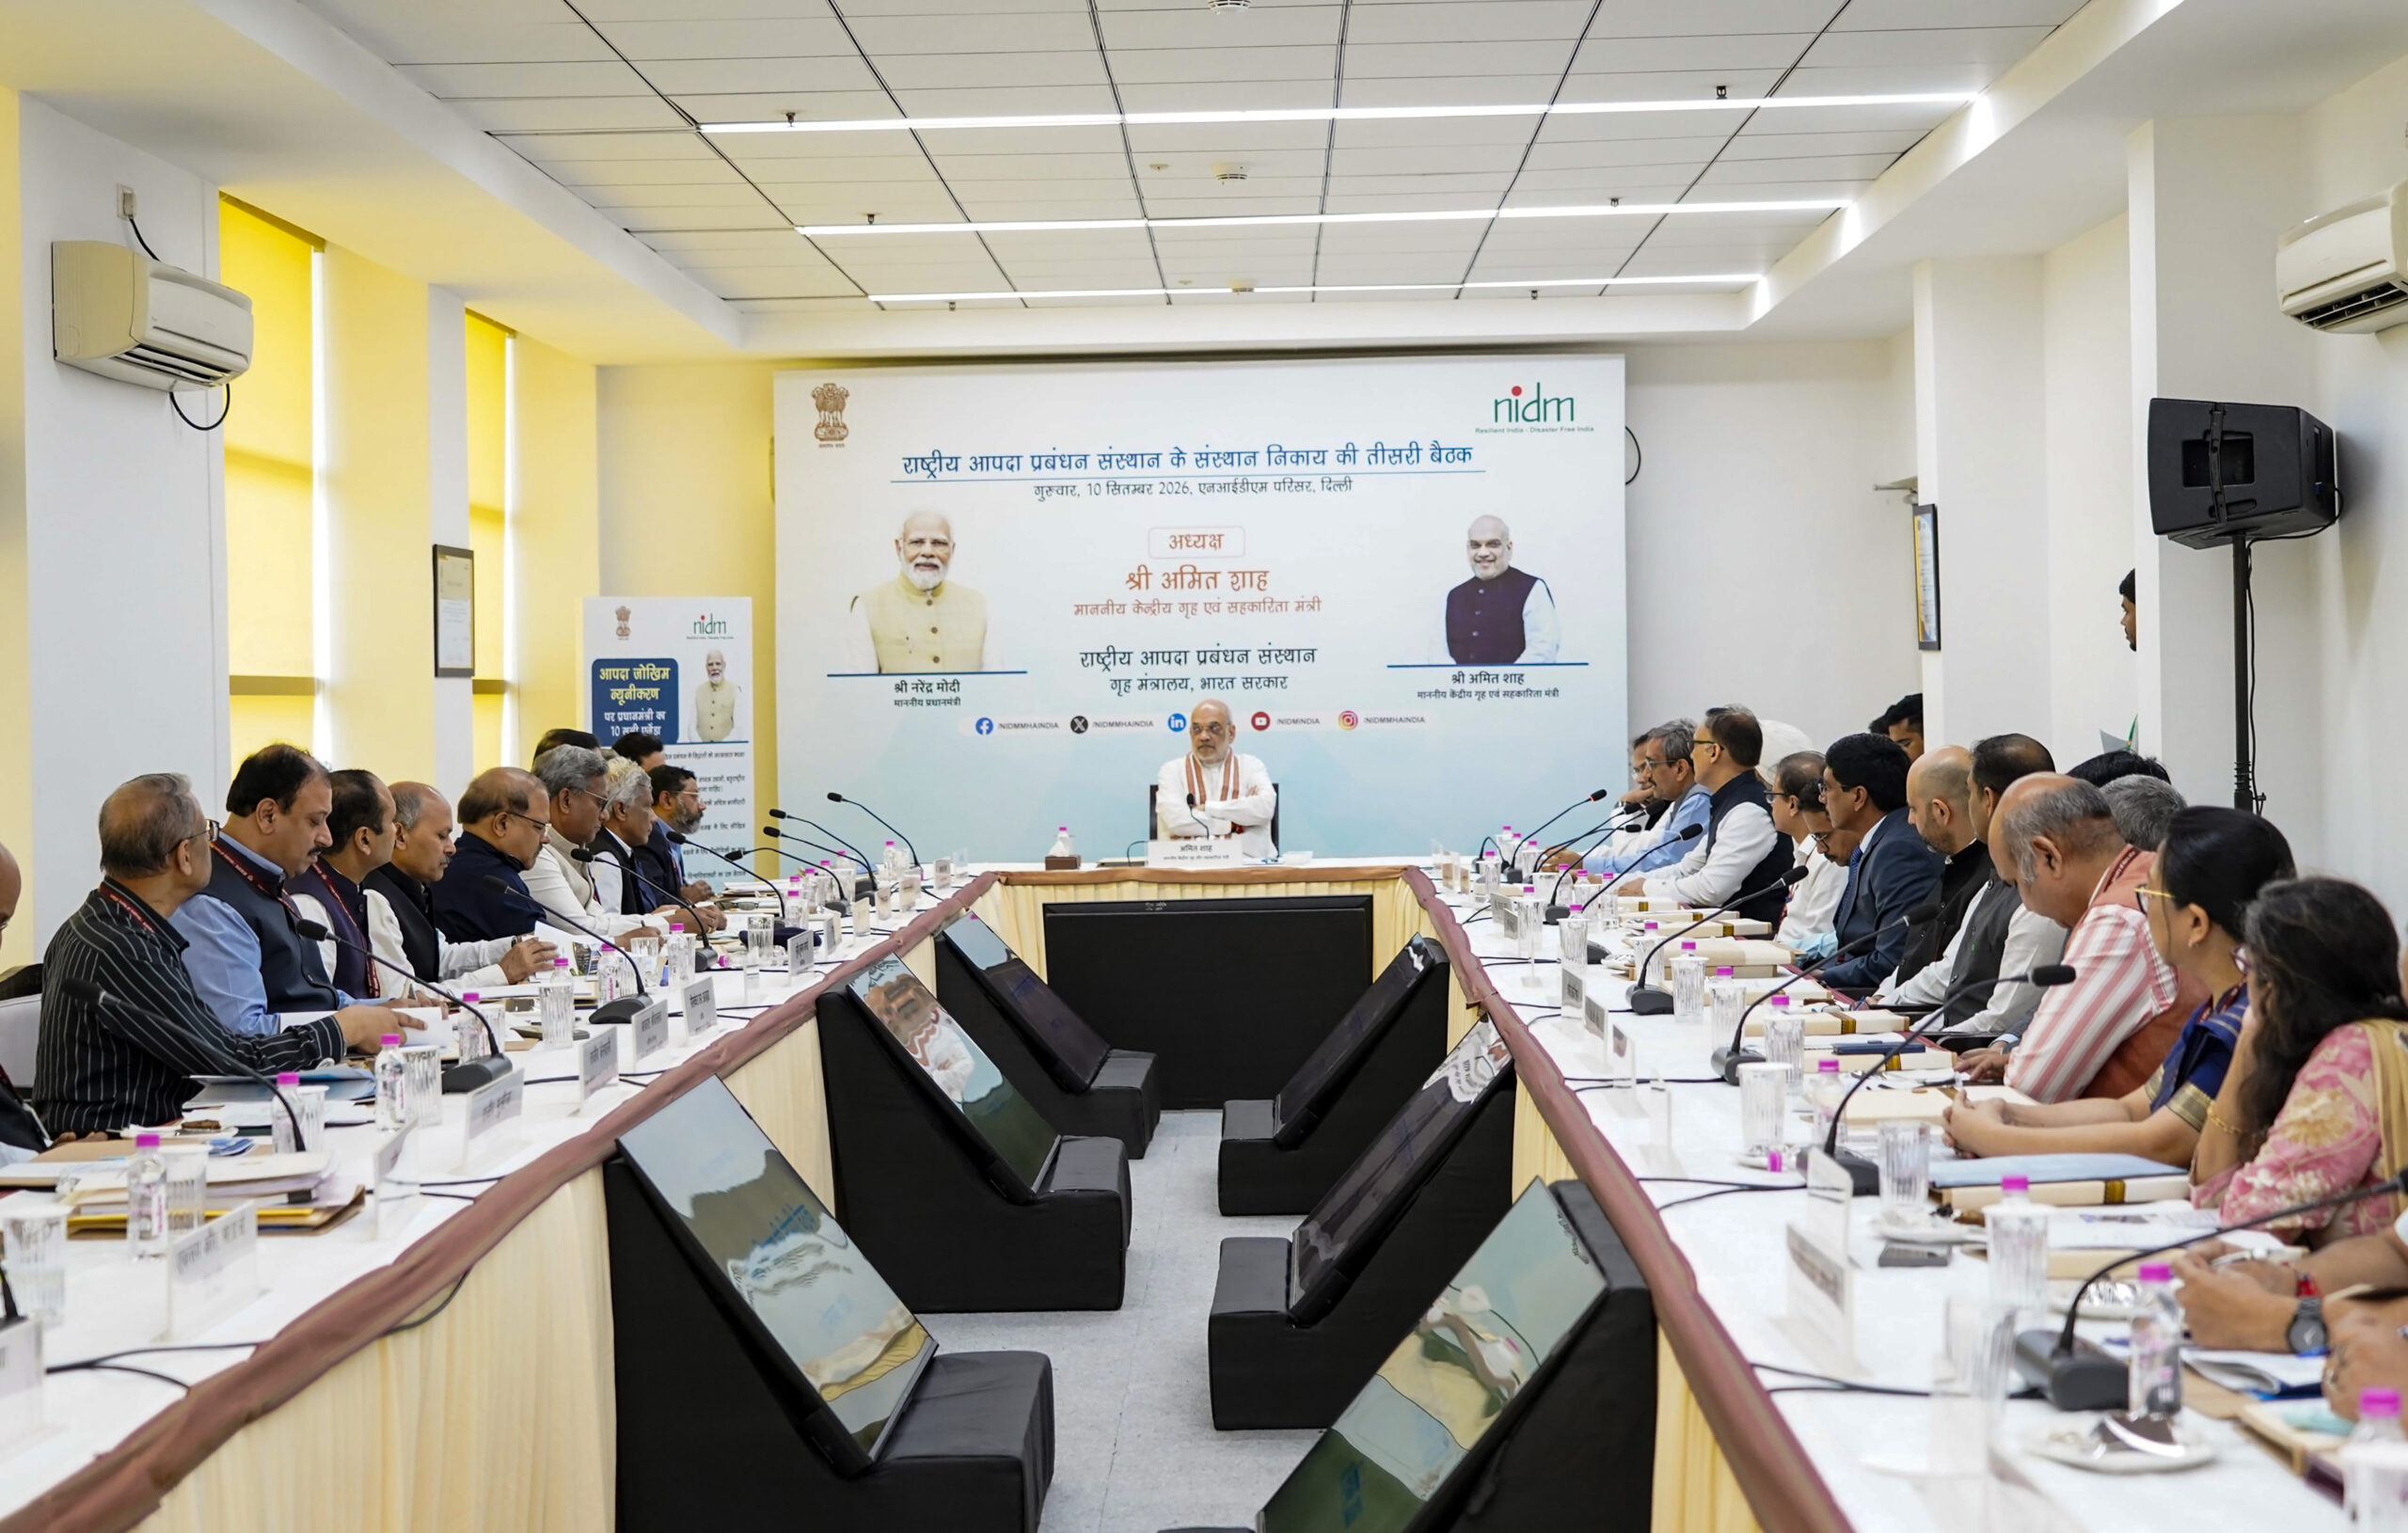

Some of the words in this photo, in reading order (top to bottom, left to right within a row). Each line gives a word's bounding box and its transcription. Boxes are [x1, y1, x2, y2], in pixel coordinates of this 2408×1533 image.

[1494, 382, 1575, 422] nidm
[902, 449, 962, 479] राष्ट्रीय
[969, 455, 1023, 472] आपदा
[1030, 447, 1091, 471] प्रबंधन
[1097, 446, 1164, 470] संस्थान
[1169, 446, 1188, 468] के
[1194, 444, 1260, 468] संस्थान
[1266, 443, 1329, 467] निकाय
[1335, 442, 1359, 466] की
[1366, 441, 1423, 466] तीसरी
[1430, 440, 1474, 465] बैठक
[1087, 483, 1101, 496] 10
[1106, 481, 1153, 496] सितम्बर
[1158, 481, 1193, 496] 2026,
[1197, 478, 1269, 495] एनआईडीएम
[1274, 479, 1316, 494] परिसर,
[1321, 476, 1353, 492] दिल्ली
[1169, 533, 1225, 550] अध्यक्ष
[1125, 564, 1153, 591] श्री
[1161, 564, 1222, 591] अमित
[1228, 570, 1270, 592] शाह
[1073, 599, 1127, 616] माननीय
[1133, 598, 1174, 617] केन्द्रीय
[1179, 602, 1198, 620] गृह
[1204, 596, 1222, 615] एवं
[1228, 597, 1290, 615] सहकारिता
[1294, 595, 1322, 613] मंत्री
[693, 612, 727, 634] nidm
[1080, 645, 1133, 672] राष्ट्रीय
[1140, 651, 1190, 666] आपदा
[1196, 643, 1251, 665] प्रबंधन
[1258, 642, 1318, 665] संस्थान
[599, 668, 630, 681] आपदा
[632, 663, 671, 681] जोखिम
[1451, 671, 1465, 685] श्री
[1468, 671, 1499, 685] अमित
[1502, 672, 1525, 686] शाह
[610, 683, 660, 705] न्यूनीकरण
[894, 680, 909, 694] श्री
[911, 680, 934, 694] नरेंद्र
[936, 679, 961, 693] मोदी
[1110, 677, 1132, 697] गृह
[1137, 672, 1195, 692] मंत्रालय,
[1199, 676, 1237, 691] भारत
[1242, 675, 1289, 690] सरकार
[1417, 688, 1447, 700] माननीय
[1474, 689, 1486, 702] गृह
[1502, 687, 1543, 700] सहकारिता
[1545, 687, 1560, 699] मंत्री
[894, 697, 924, 707] माननीय
[926, 697, 961, 707] प्रधानमंत्री
[604, 711, 615, 721] पर
[617, 707, 655, 721] प्रधानमंत्री
[656, 711, 666, 720] का
[610, 725, 621, 736] 10
